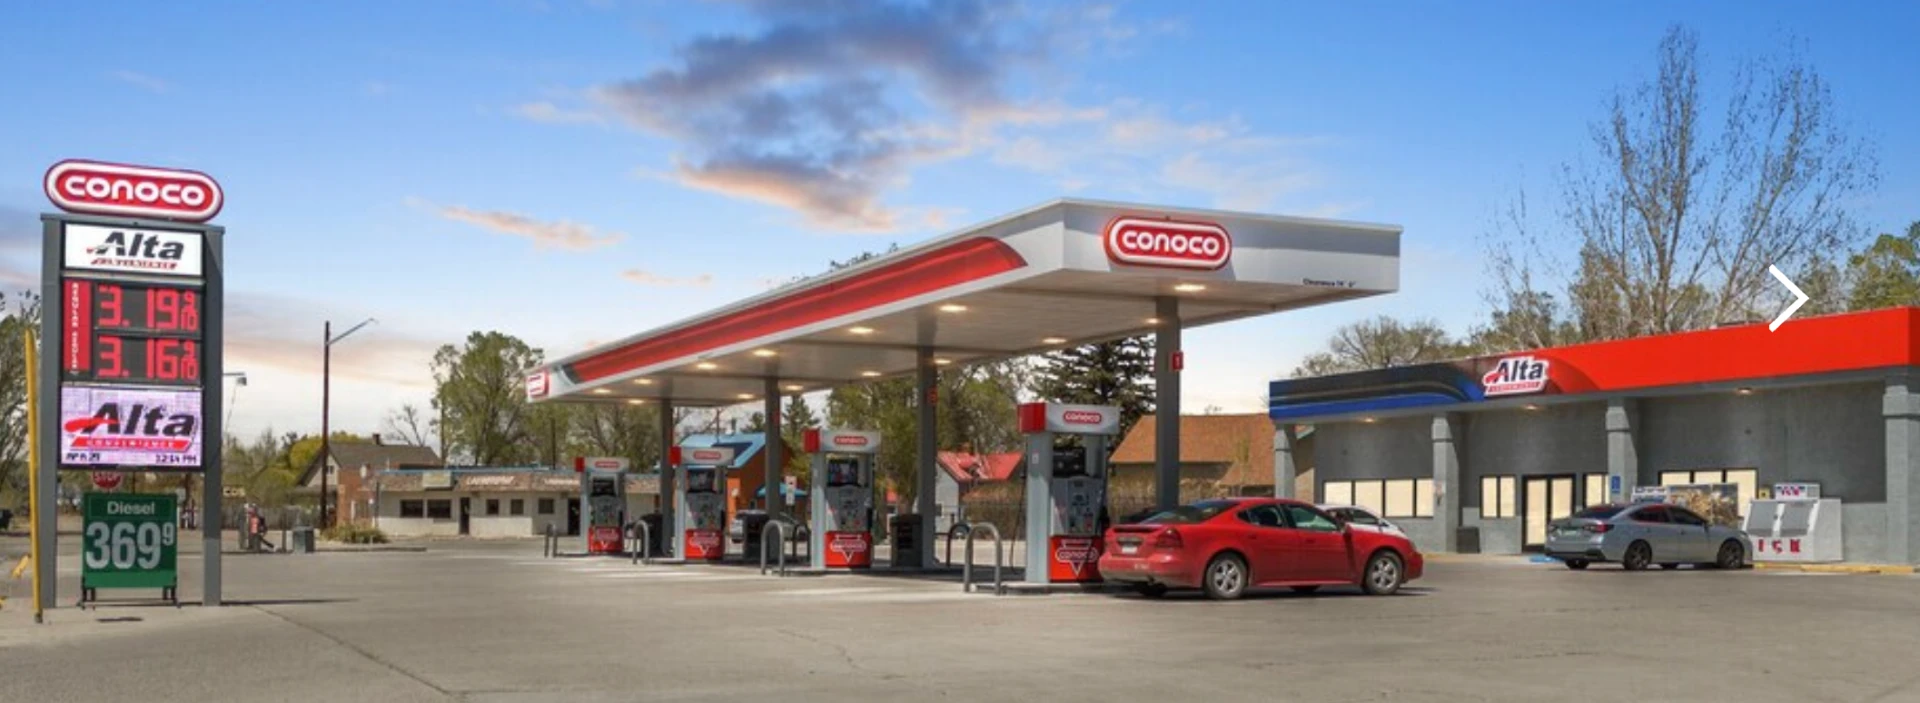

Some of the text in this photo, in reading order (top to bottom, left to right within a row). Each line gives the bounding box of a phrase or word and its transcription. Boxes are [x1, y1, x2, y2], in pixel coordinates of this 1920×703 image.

[95, 231, 184, 260] Alta
[1493, 360, 1544, 384] Alta
[82, 402, 194, 437] Alta
[107, 501, 155, 515] Diesel
